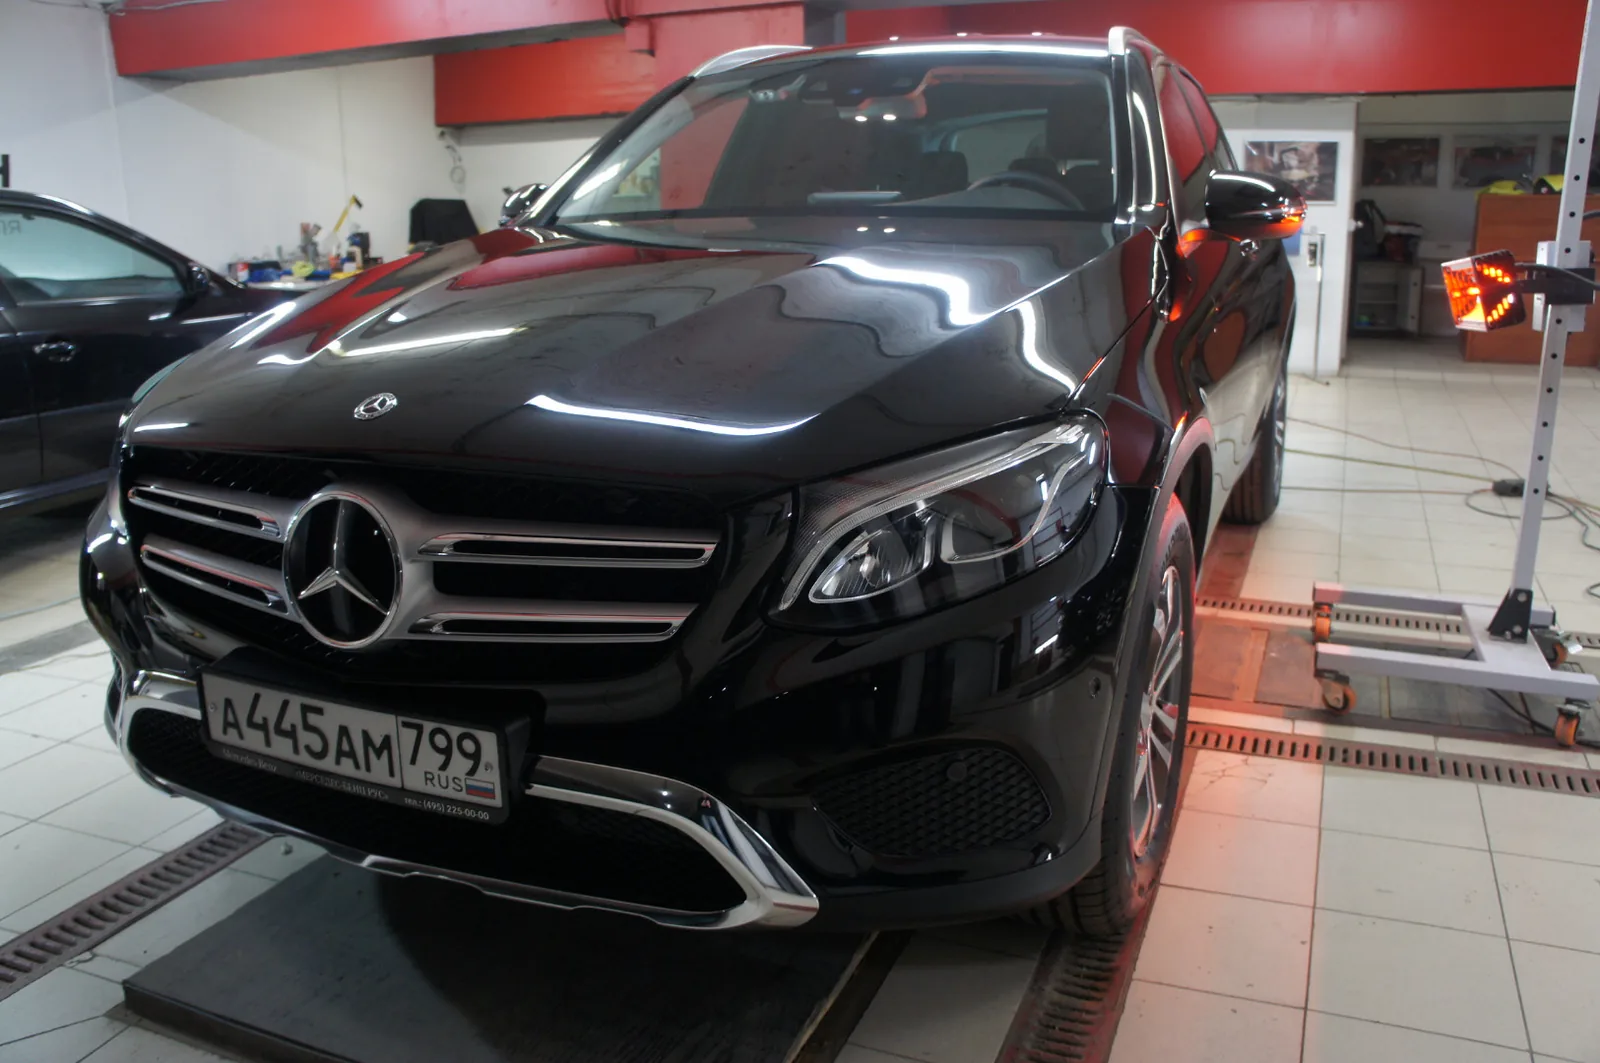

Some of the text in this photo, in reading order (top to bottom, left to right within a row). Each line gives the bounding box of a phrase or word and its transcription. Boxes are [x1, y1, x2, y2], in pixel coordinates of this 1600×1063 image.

[401, 720, 482, 777] 799
[424, 771, 463, 792] RUS
[423, 800, 445, 813] (495)
[447, 804, 490, 820] 225-00-00
